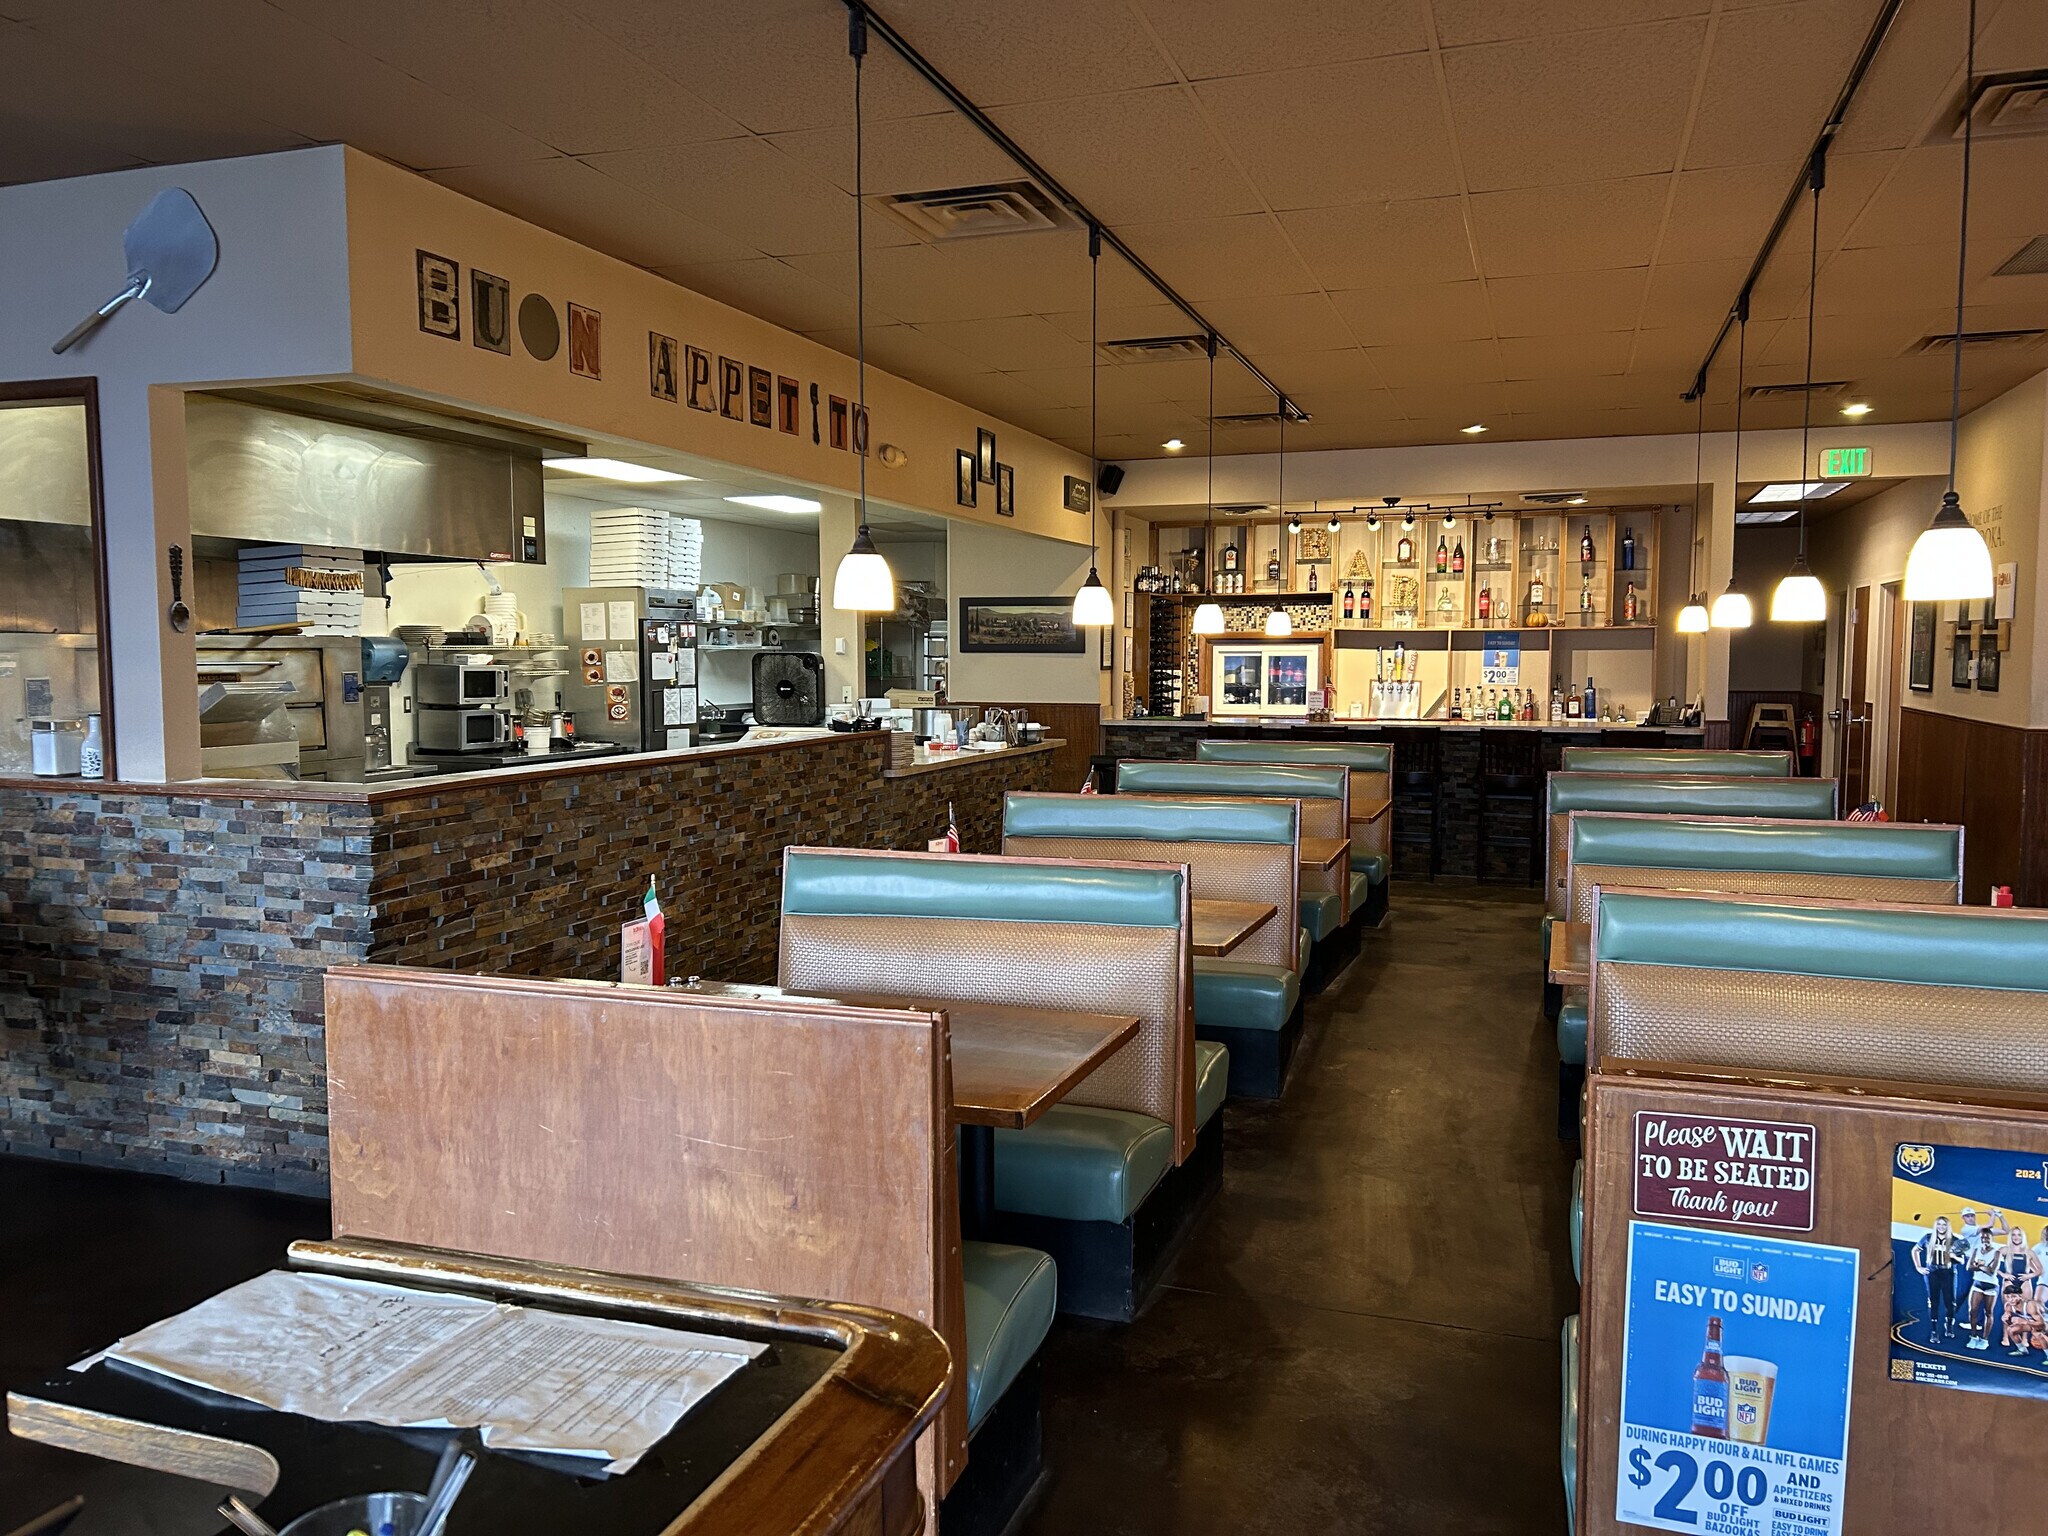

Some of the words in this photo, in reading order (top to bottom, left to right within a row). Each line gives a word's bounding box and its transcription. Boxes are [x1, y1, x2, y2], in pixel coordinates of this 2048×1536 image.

[1828, 448, 1867, 475] EXIT
[1645, 1120, 1717, 1147] Please
[1718, 1126, 1809, 1163] WAIT
[1639, 1153, 1672, 1178] TO
[1676, 1157, 1709, 1182] BE
[1713, 1160, 1810, 1191] SEATED
[2015, 1169, 2041, 1179] 2024
[1668, 1186, 1728, 1213] Thank
[1732, 1200, 1778, 1221] you!
[1715, 1265, 1742, 1275] LIGHT
[1719, 1258, 1739, 1268] BUD
[1752, 1269, 1767, 1281] NFL
[1655, 1279, 1707, 1308] EASY
[1711, 1288, 1738, 1312] TO
[1741, 1294, 1826, 1325] SUNDAY
[1916, 1361, 1946, 1371] TICKETS
[1735, 1383, 1762, 1394] LIGHT
[1740, 1378, 1758, 1387] BUD
[1697, 1394, 1723, 1408] BUD
[1693, 1404, 1726, 1418] LIGHT
[1738, 1412, 1755, 1421] NFL
[1626, 1425, 1668, 1444] DURING
[1669, 1431, 1706, 1454] HAPPY
[1708, 1440, 1740, 1459] HOUR
[1742, 1446, 1750, 1459] &
[1751, 1447, 1773, 1464] ALL
[1775, 1452, 1797, 1468] NFL
[1799, 1456, 1839, 1475] GAMES
[1786, 1472, 1821, 1489] AND
[1773, 1484, 1833, 1504] APPETIZERS
[1719, 1502, 1749, 1517] OFF
[1774, 1495, 1780, 1503] &
[1780, 1497, 1803, 1507] MIXED
[1804, 1501, 1831, 1512] DRINKS
[1707, 1511, 1728, 1523] BUD
[1729, 1515, 1760, 1529] LIGHT
[1775, 1510, 1796, 1520] BUD
[1797, 1514, 1828, 1525] LIGHT
[1705, 1520, 1760, 1536] BAZOOKAS
[1771, 1520, 1793, 1530] EASY
[1793, 1523, 1803, 1534] TO
[1804, 1526, 1829, 1536] DRINK
